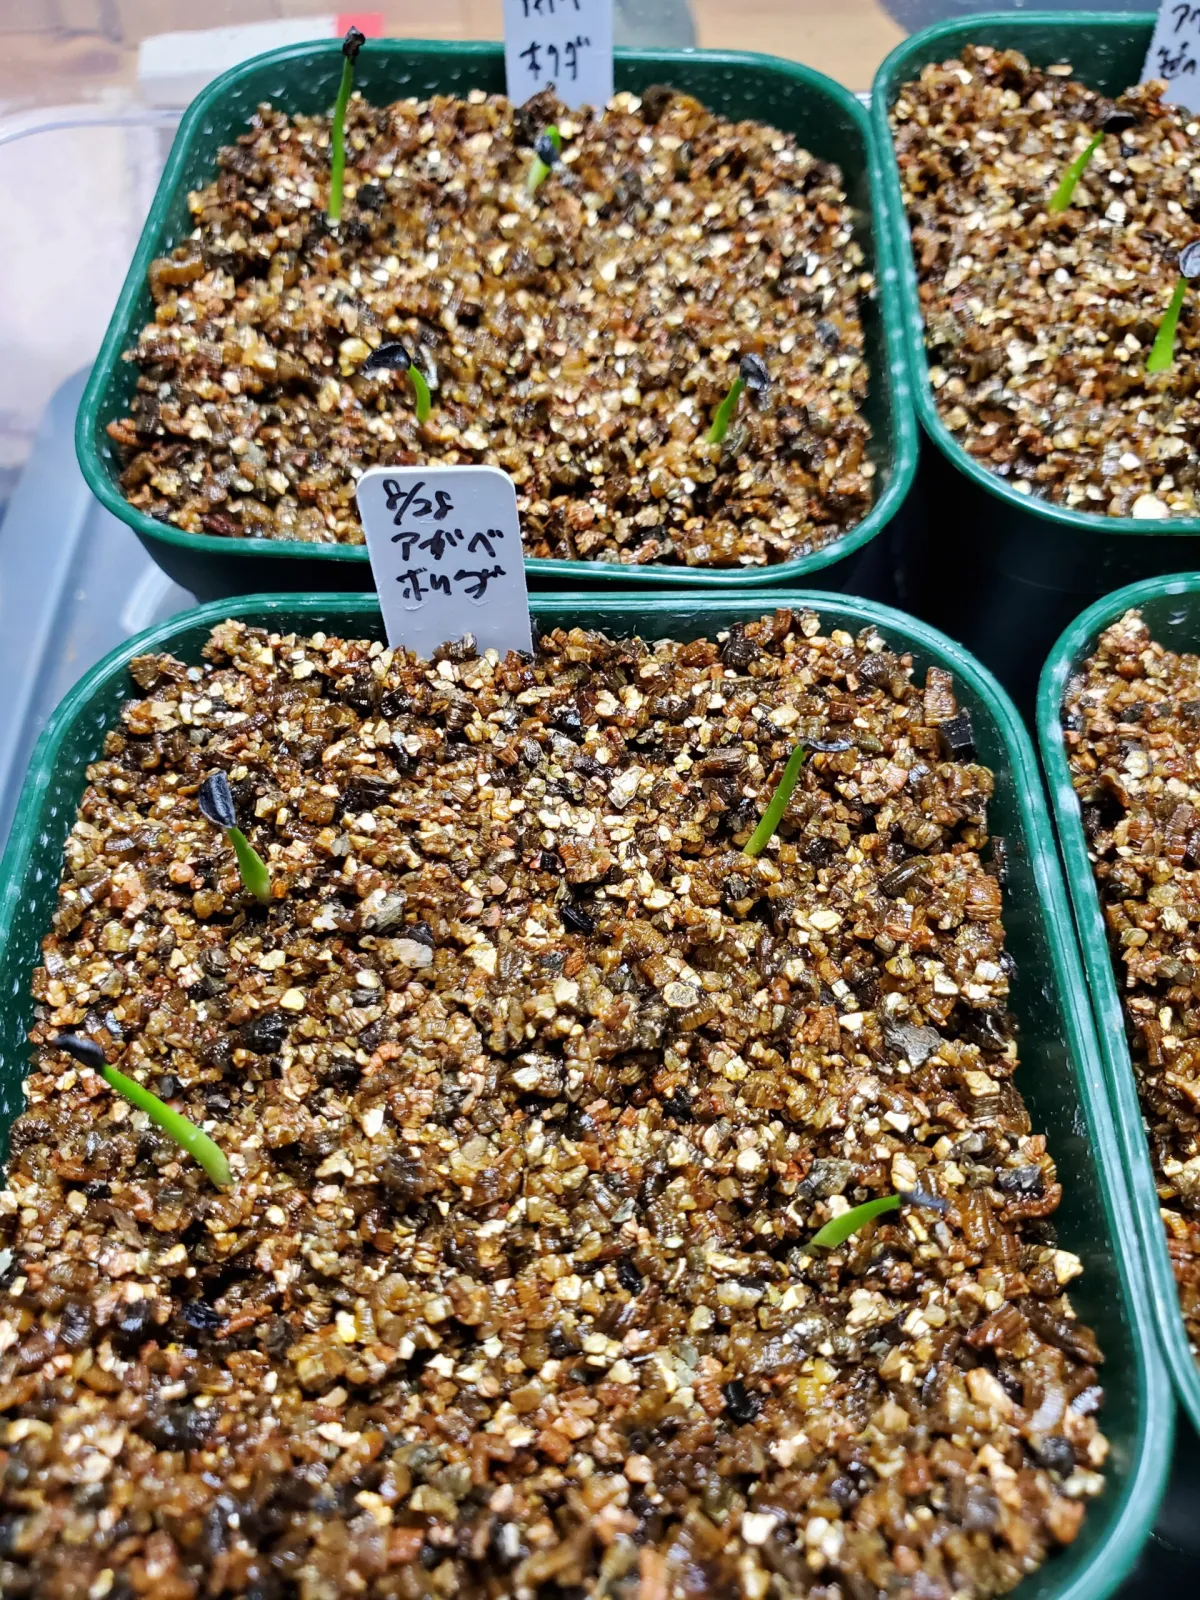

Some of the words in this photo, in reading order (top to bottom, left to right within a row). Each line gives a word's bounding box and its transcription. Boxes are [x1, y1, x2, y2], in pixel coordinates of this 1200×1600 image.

[383, 479, 454, 525] 8/28
[391, 528, 504, 561] アガベ
